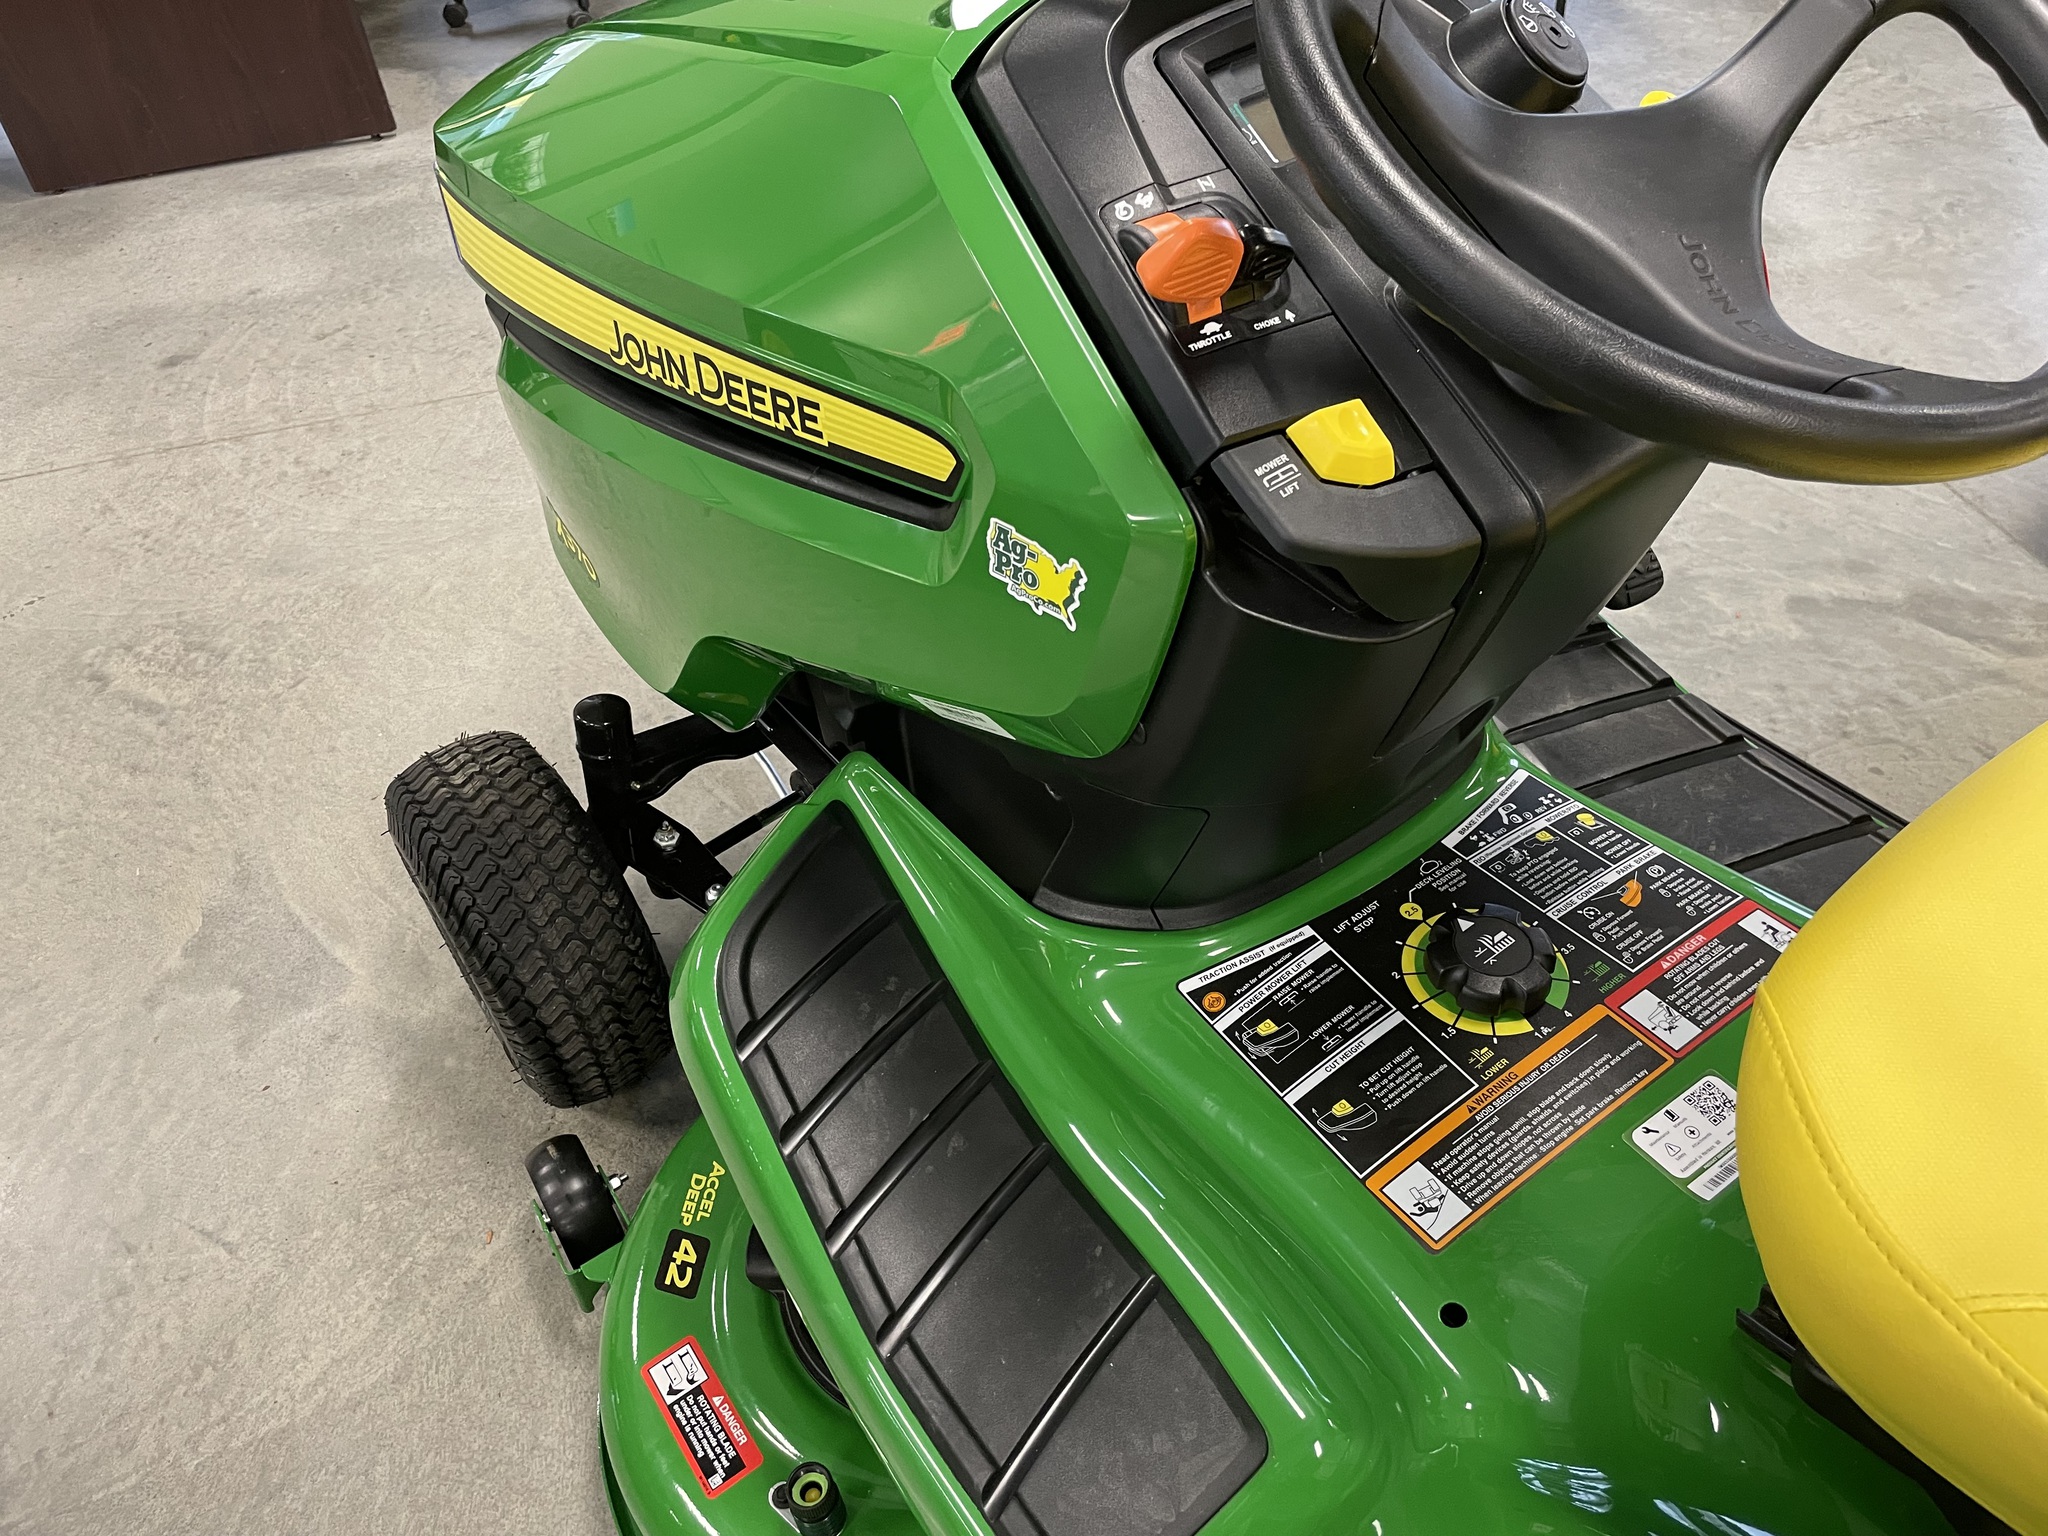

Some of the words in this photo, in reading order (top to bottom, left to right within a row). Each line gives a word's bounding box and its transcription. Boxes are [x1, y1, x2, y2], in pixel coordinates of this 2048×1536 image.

[1679, 235, 1739, 314] JOHN
[1188, 331, 1232, 351] THROTTLE
[1253, 316, 1281, 330] CHOKE
[610, 320, 690, 389] JOHN
[693, 352, 825, 440] DEERE
[1254, 454, 1290, 476] MOWER
[1279, 481, 1300, 498] LIFT
[993, 526, 1037, 564] Ag-
[994, 549, 1038, 588] Pro
[1011, 583, 1062, 615] AgProCo.com
[1457, 819, 1476, 835] BRAKE
[1475, 797, 1499, 818] FORWARD
[1497, 778, 1518, 796] REVERSE
[1534, 804, 1548, 813] REV
[1492, 826, 1507, 837] FWD
[1415, 876, 1432, 890] DECK
[1432, 858, 1462, 879] LEVELING
[1432, 868, 1461, 888] POSITION
[1551, 899, 1577, 916] CRUISE
[1576, 879, 1608, 900] CONTROL
[1615, 863, 1635, 875] PARK
[1633, 850, 1657, 864] BRAKE
[1333, 919, 1351, 934] LIFT
[1351, 900, 1380, 923] ADJUST
[1353, 917, 1374, 933] STOP
[1404, 906, 1418, 917] 2.5
[1197, 962, 1238, 982] TRACTION
[1236, 949, 1267, 965] ASSIST
[1274, 931, 1306, 948] equipped)
[1561, 944, 1575, 956] 3.5
[1663, 959, 1690, 979] ROTATING
[1687, 945, 1710, 962] BLADES
[1707, 938, 1720, 947] CUT
[1666, 934, 1706, 963] DANGER
[1672, 972, 1686, 982] OFF
[1683, 961, 1701, 975] ARMS
[1698, 953, 1712, 964] AND
[1709, 944, 1725, 956] LEGS
[1235, 982, 1250, 994] Push
[1248, 976, 1258, 984] for
[1256, 965, 1273, 978] added
[1272, 951, 1292, 967] traction
[1237, 990, 1266, 1012] POWER
[1264, 970, 1293, 992] MOWER
[1291, 959, 1308, 972] LIFT
[1271, 985, 1292, 1001] RAISE
[1290, 968, 1315, 987] MOWER
[1392, 972, 1400, 980] 2
[1599, 973, 1626, 994] HIGHER
[1308, 1020, 1332, 1039] LOWER
[1330, 1004, 1355, 1023] MOWER
[1564, 1010, 1573, 1018] 4
[1441, 1027, 1456, 1040] 1.5
[1323, 1058, 1340, 1072] CUT
[1338, 1039, 1366, 1061] HEIGHT
[1358, 1080, 1369, 1089] TO
[1367, 1071, 1381, 1082] SET
[1379, 1061, 1394, 1073] CUT
[1391, 1045, 1415, 1064] HEIGHT
[1368, 1083, 1381, 1093] Pull
[1394, 1066, 1403, 1074] lift
[1401, 1054, 1420, 1068] handle
[1480, 1058, 1510, 1081] LOWER
[1386, 1097, 1402, 1109] Push
[1400, 1086, 1416, 1099] down
[1429, 1062, 1448, 1077] handle
[1472, 1070, 1519, 1106] WARNING
[1473, 1104, 1495, 1121] AVOID
[1491, 1084, 1521, 1107] SERIOUS
[1517, 1069, 1541, 1087] INJURY
[1539, 1062, 1551, 1071] OR
[1548, 1047, 1570, 1064] DEATH
[1451, 1154, 1478, 1176] machine
[1475, 1141, 1495, 1157] stops
[1492, 1129, 1512, 1145] going
[1525, 1105, 1542, 1119] stop
[1538, 1094, 1556, 1108] blade
[1553, 1086, 1567, 1096] and
[1564, 1076, 1580, 1088] back
[1577, 1064, 1595, 1078] down
[1592, 1052, 1612, 1067] slowly
[1452, 1171, 1471, 1187] Keep
[1468, 1157, 1489, 1175] safety
[1486, 1140, 1510, 1160] devices
[1551, 1098, 1565, 1109] and
[1593, 1063, 1611, 1077] place
[1608, 1055, 1621, 1065] and
[1618, 1039, 1643, 1058] working
[1432, 1153, 1450, 1167] Read
[1476, 1115, 1499, 1133] manual
[1439, 1158, 1458, 1173] Avoid
[1456, 1141, 1480, 1160] sudden
[1477, 1129, 1495, 1144] turns
[1459, 1177, 1477, 1191] Drive
[1476, 1171, 1487, 1180] up
[1483, 1161, 1497, 1172] and
[1495, 1149, 1513, 1163] down
[1531, 1125, 1544, 1135] not
[1542, 1111, 1562, 1127] across
[1466, 1177, 1492, 1198] Remove
[1490, 1160, 1514, 1180] objects
[1511, 1151, 1525, 1163] that
[1523, 1143, 1536, 1153] can
[1533, 1136, 1544, 1145] be
[1541, 1121, 1563, 1139] thrown
[1560, 1115, 1572, 1124] by
[1568, 1103, 1586, 1118] blade
[1473, 1188, 1493, 1204] When
[1490, 1171, 1515, 1191] leaving
[1552, 1124, 1575, 1142] engine
[1584, 1105, 1600, 1118] park
[1596, 1093, 1614, 1108] brake
[1635, 1068, 1649, 1079] key
[681, 1173, 707, 1226] DEEP
[696, 1161, 726, 1221] ACCEL
[664, 1238, 697, 1288] 42
[671, 1403, 687, 1426] engine
[684, 1424, 691, 1432] is
[686, 1394, 695, 1405] Do
[691, 1403, 701, 1416] not
[696, 1414, 707, 1428] put
[703, 1425, 718, 1446] hands
[714, 1445, 721, 1455] or
[718, 1453, 730, 1468] feet
[696, 1394, 721, 1432] ROTATING
[717, 1430, 736, 1458] BLADE
[718, 1402, 747, 1445] DANGER
[679, 1399, 692, 1418] under
[689, 1417, 696, 1426] or
[693, 1424, 704, 1438] into
[700, 1438, 715, 1460] mower
[712, 1458, 726, 1478] when
[686, 1430, 704, 1458] running
